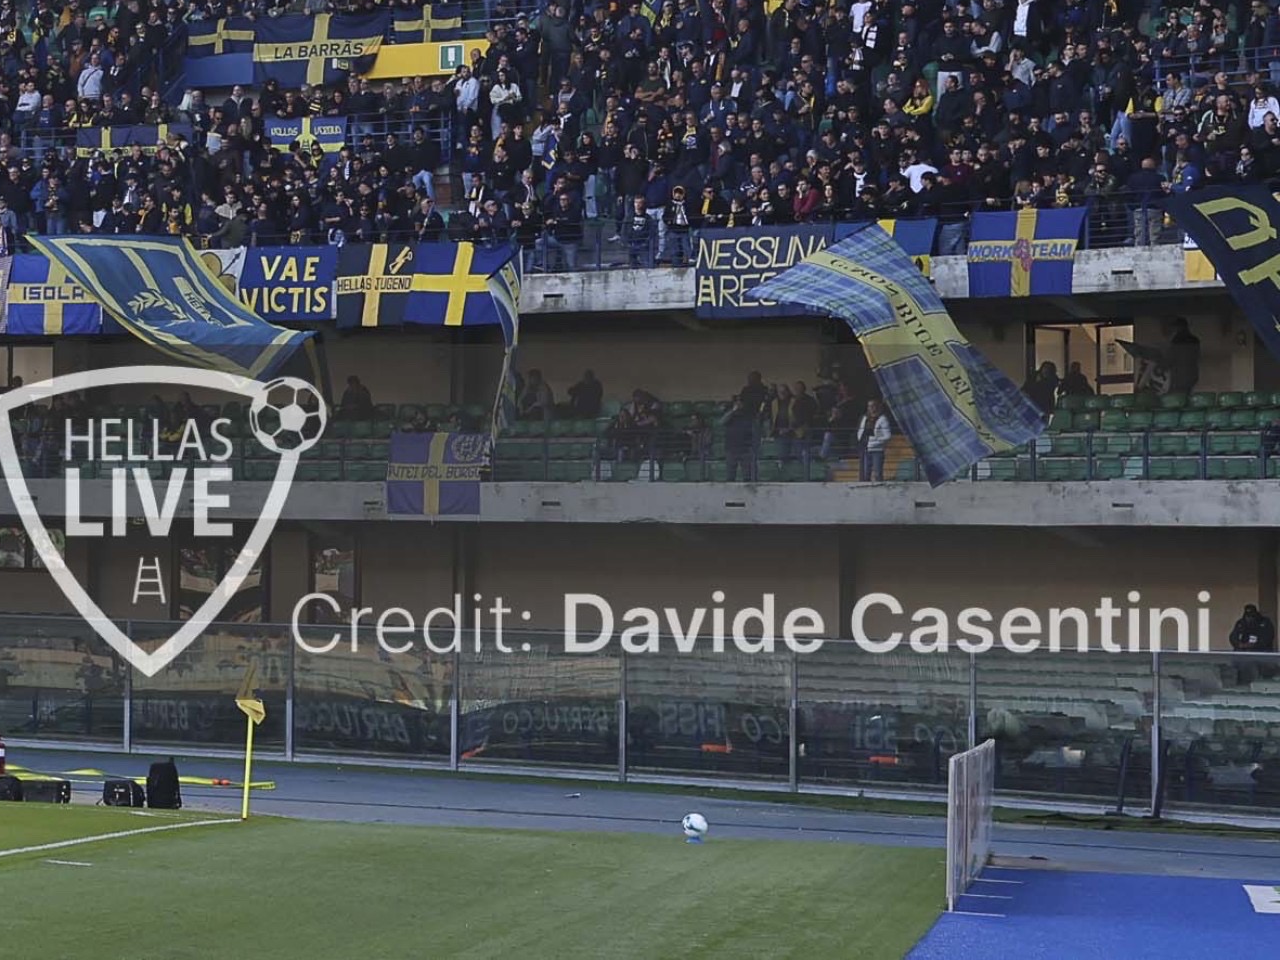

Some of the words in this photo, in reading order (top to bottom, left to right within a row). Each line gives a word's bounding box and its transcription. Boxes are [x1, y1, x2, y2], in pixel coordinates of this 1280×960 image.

[274, 47, 294, 59] LA
[970, 243, 1014, 258] WORK
[1032, 243, 1072, 257] TEAM
[260, 255, 320, 282] VAE
[337, 278, 371, 291] HELLAS
[374, 277, 411, 290] JUGEND
[23, 286, 84, 300] ISOLA
[241, 287, 329, 314] VICTIS
